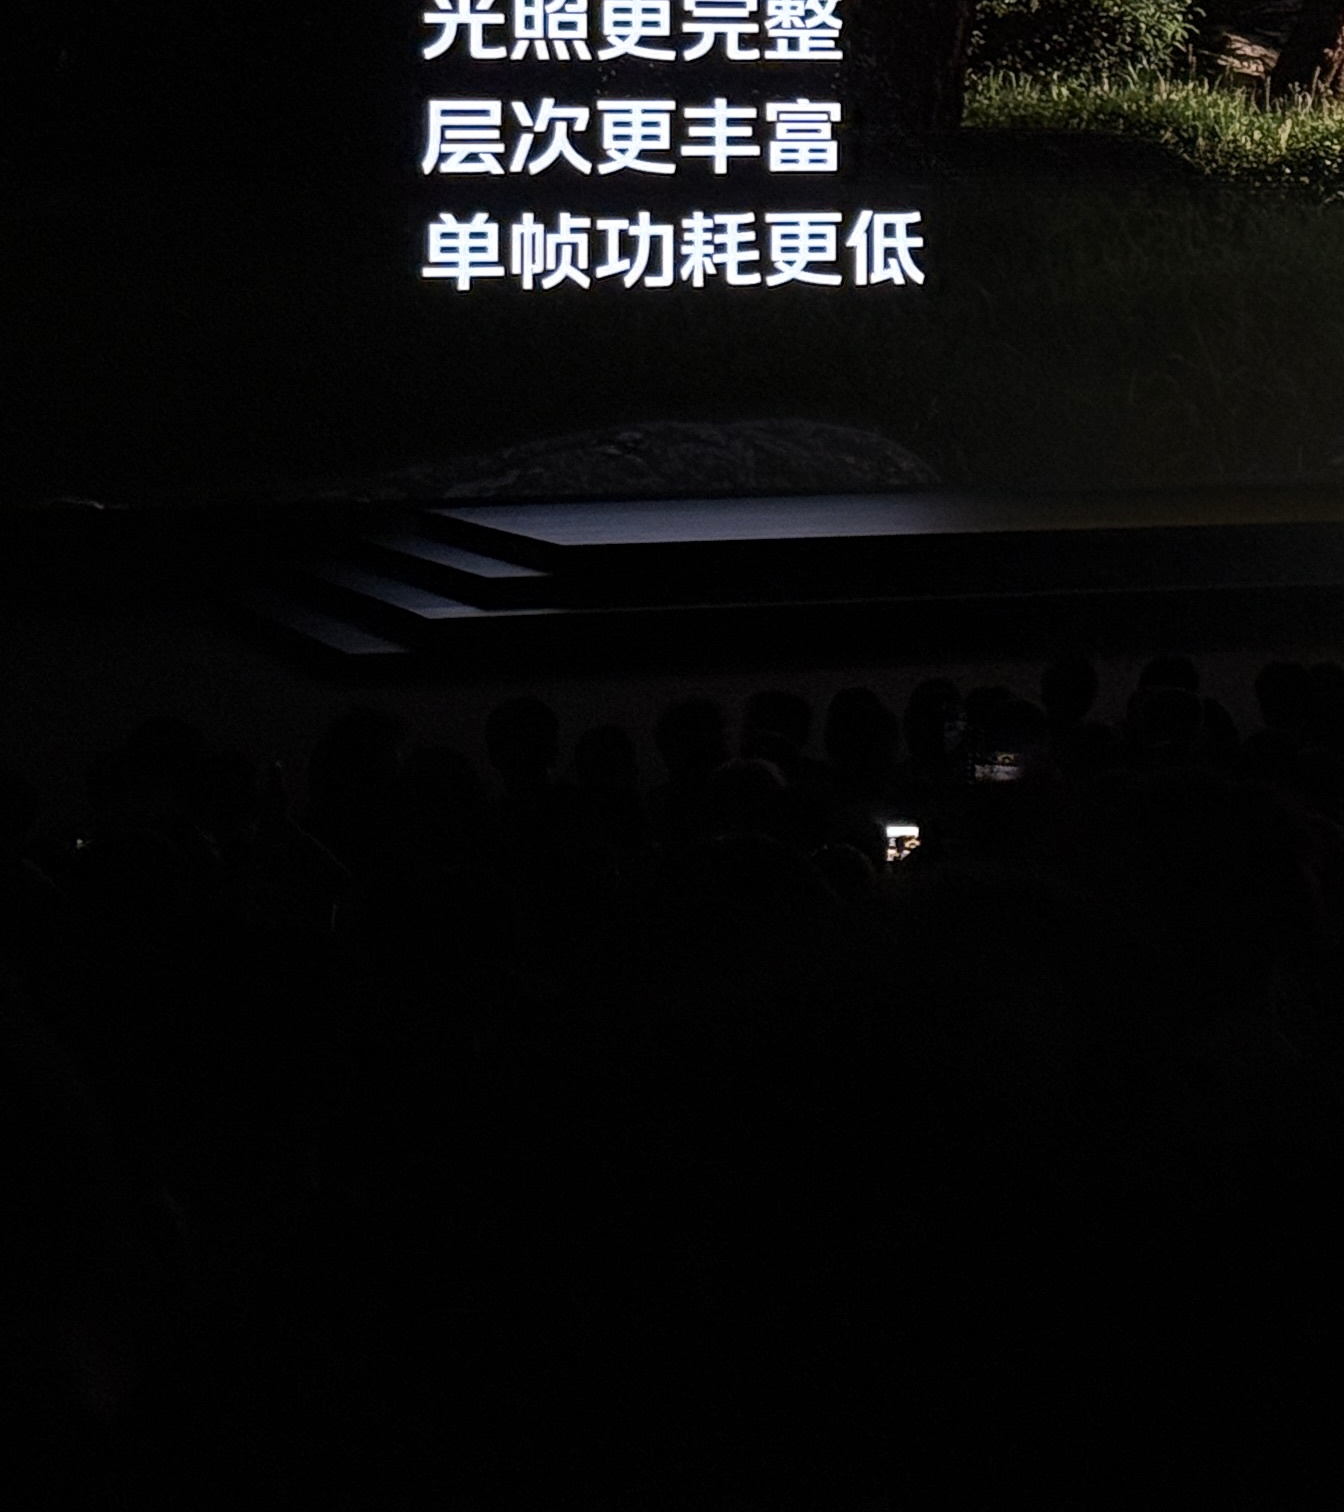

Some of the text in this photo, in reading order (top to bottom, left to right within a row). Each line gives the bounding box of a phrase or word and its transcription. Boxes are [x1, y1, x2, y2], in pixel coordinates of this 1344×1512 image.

[421, 97, 842, 175] 层次更丰富
[421, 209, 925, 291] 单帧功耗更低
